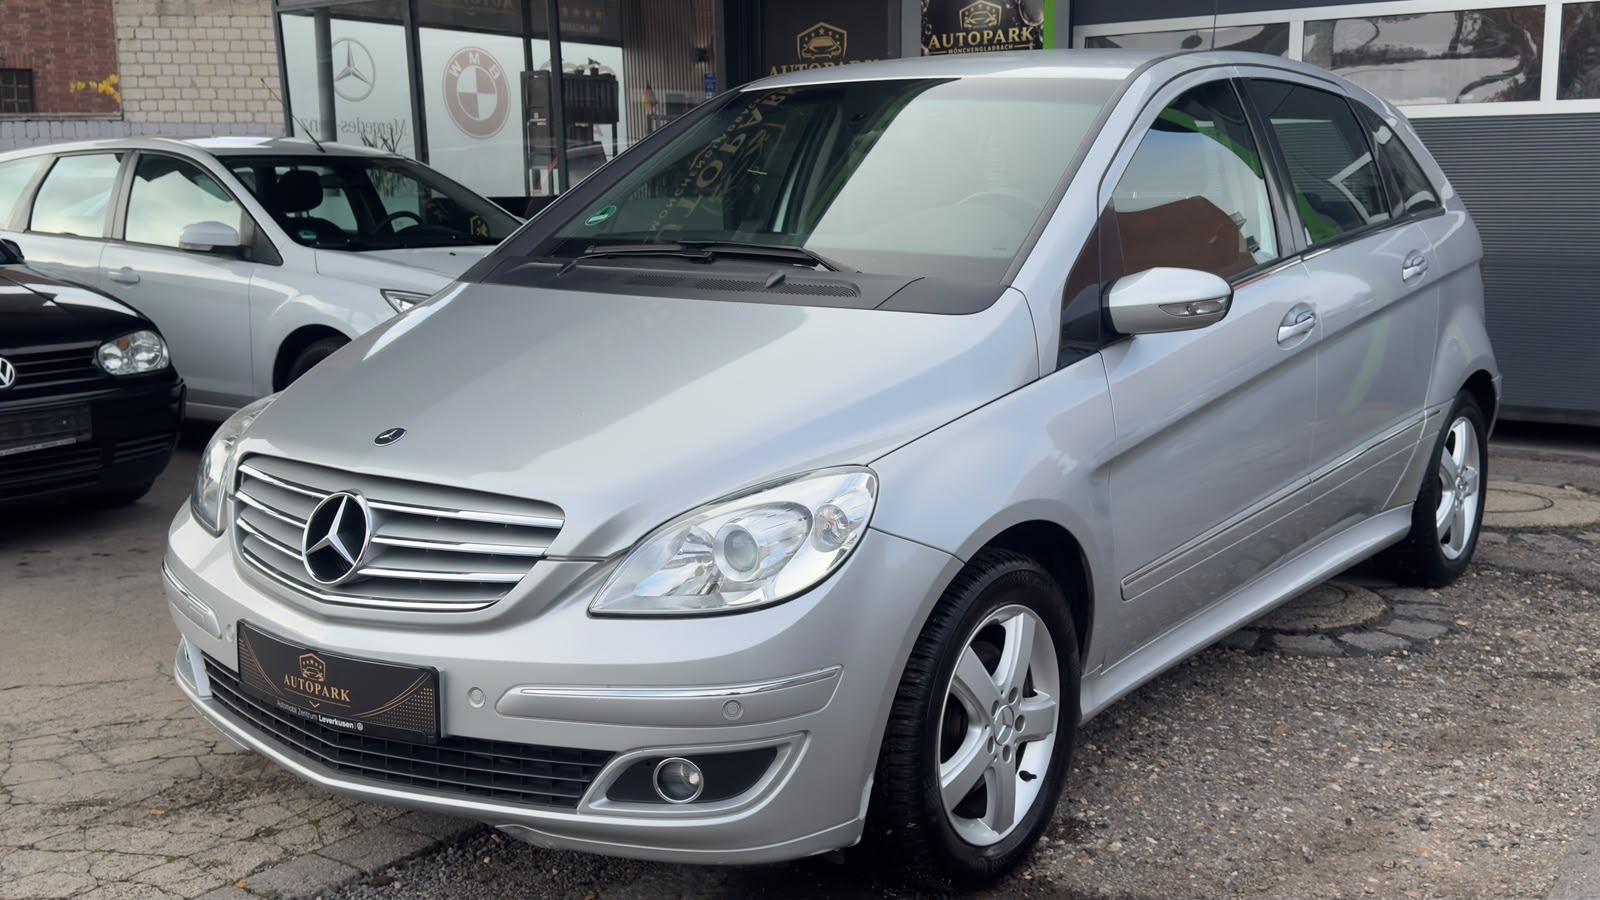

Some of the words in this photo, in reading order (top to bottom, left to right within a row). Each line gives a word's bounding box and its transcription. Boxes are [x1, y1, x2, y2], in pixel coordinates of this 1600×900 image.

[928, 26, 1034, 49] AUTOPARK
[769, 59, 880, 77] AUTOP
[283, 673, 351, 702] AUTOPARK
[319, 714, 354, 729] Leverkusen
